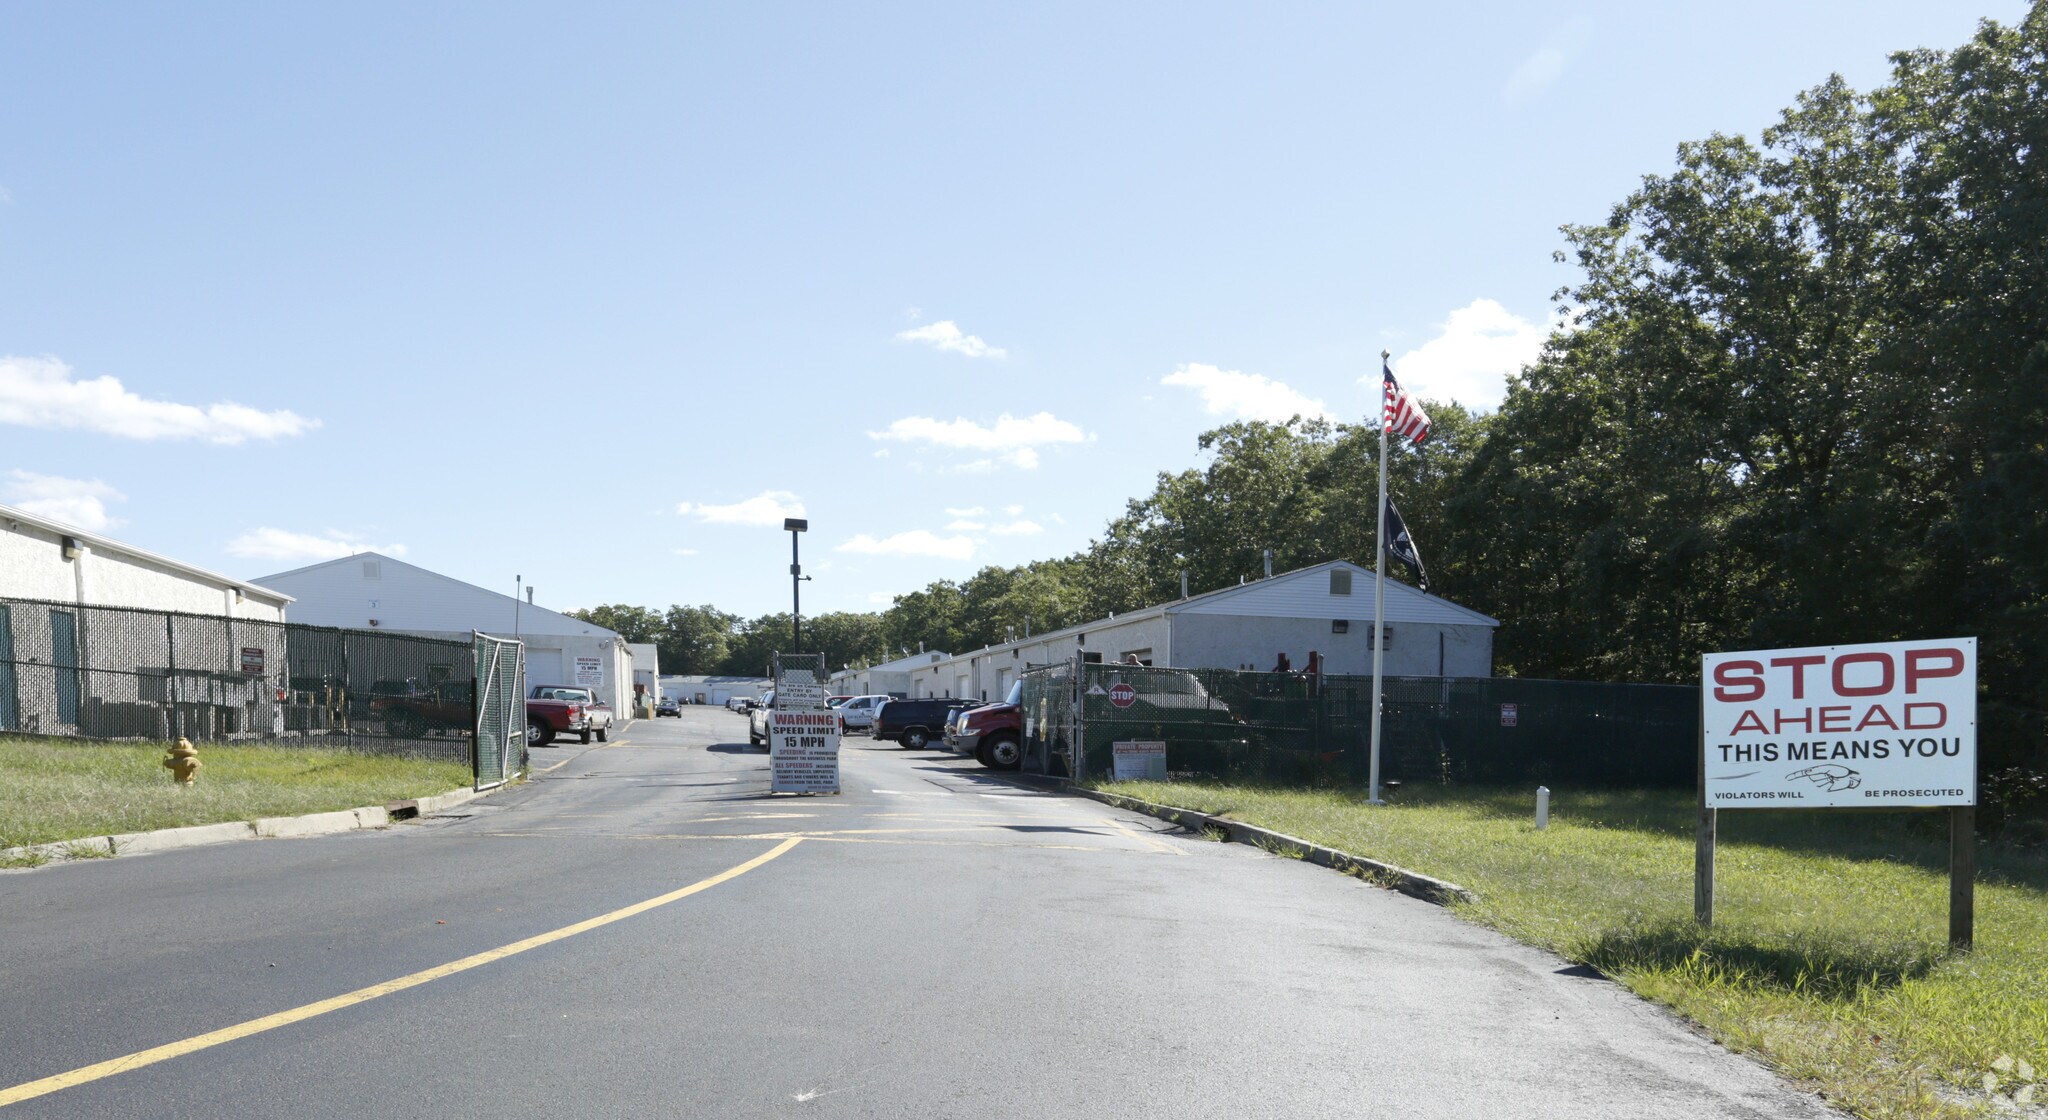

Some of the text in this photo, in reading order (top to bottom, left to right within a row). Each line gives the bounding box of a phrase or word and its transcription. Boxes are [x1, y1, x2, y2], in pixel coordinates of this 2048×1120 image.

[1713, 648, 1965, 703] STOP
[1111, 691, 1134, 700] STOP
[775, 714, 834, 725] WARNING
[1729, 702, 1948, 736] AHEAD
[773, 727, 836, 735] SPEED LIMIT
[784, 737, 825, 747] 15 MPH
[1718, 737, 1960, 762] THIS MEANS YOU
[1777, 791, 1804, 799] WILL
[1882, 789, 1964, 797] PROSECUTED
